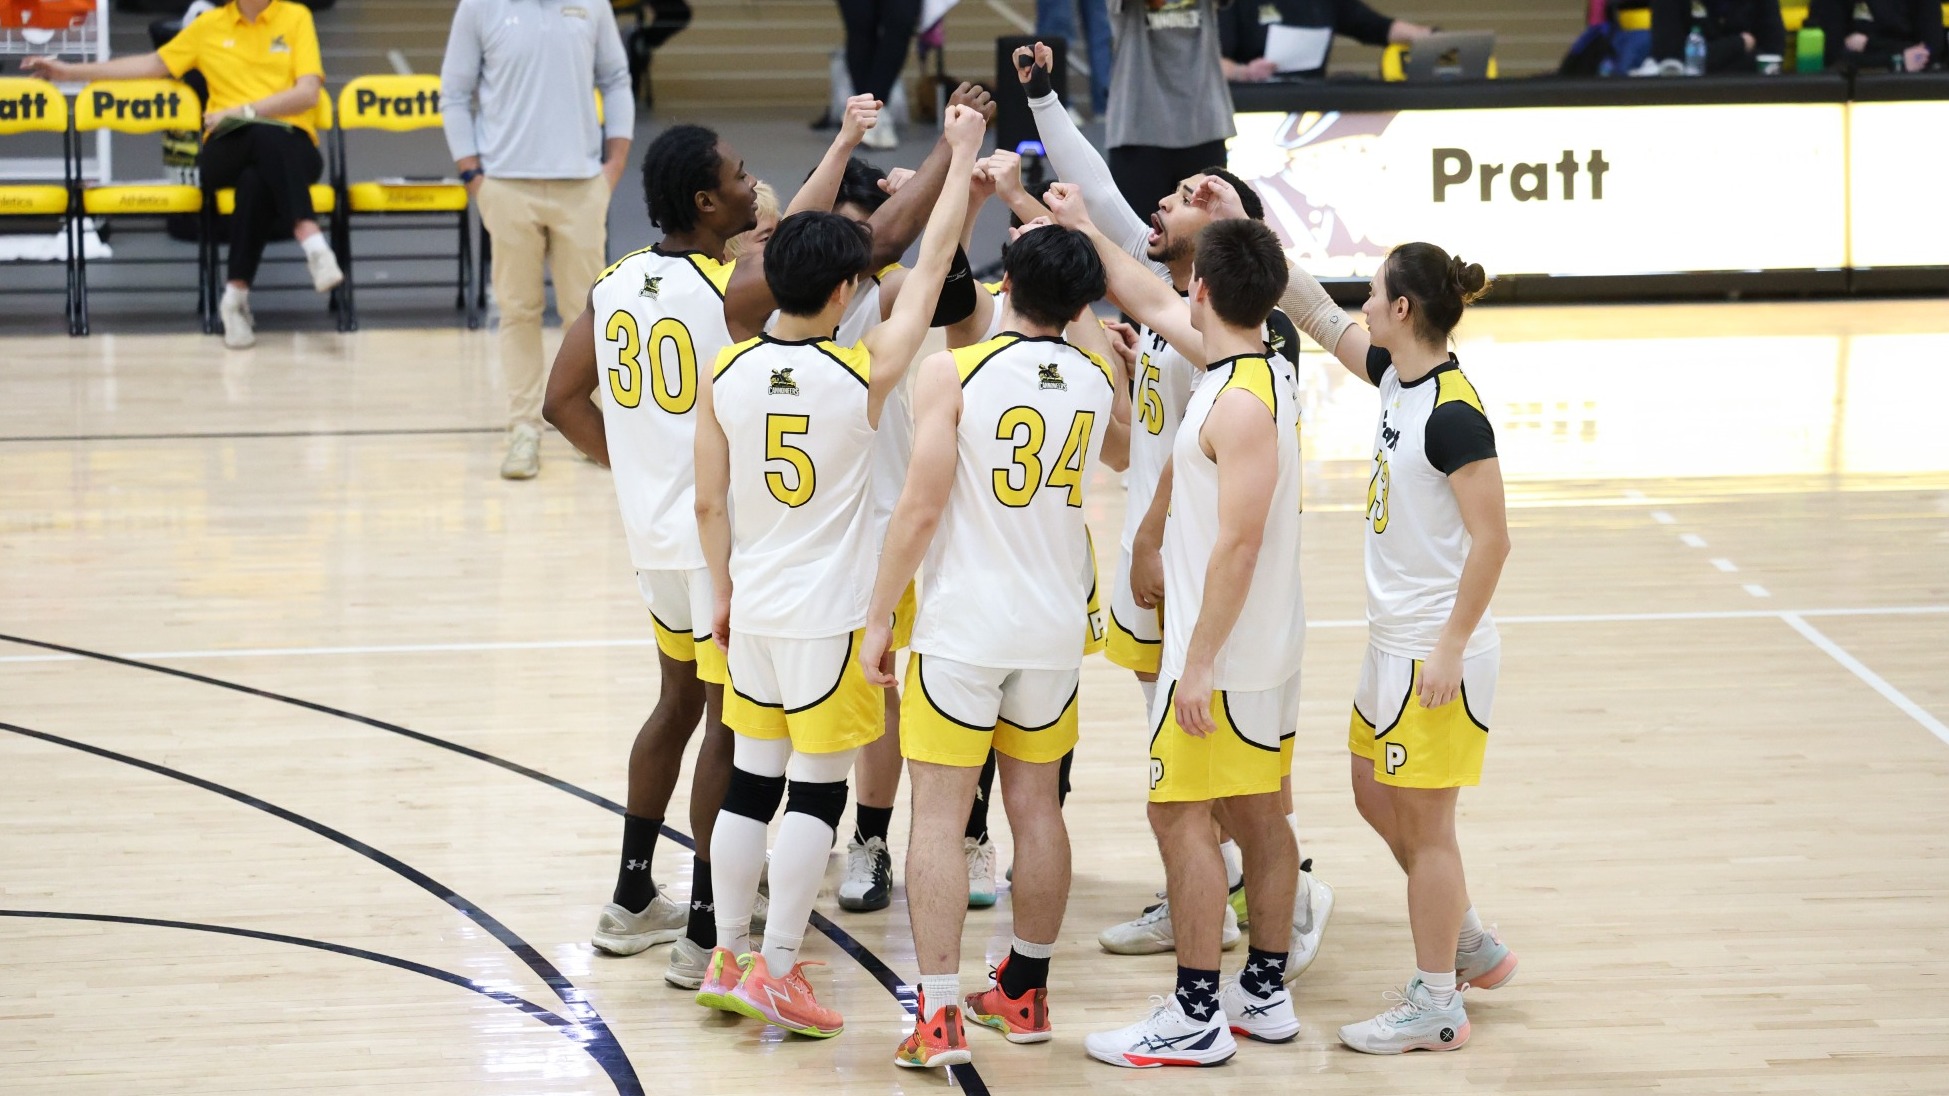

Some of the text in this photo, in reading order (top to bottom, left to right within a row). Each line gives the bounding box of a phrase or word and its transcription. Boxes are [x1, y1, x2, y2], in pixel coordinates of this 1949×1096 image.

[93, 91, 180, 118] Pratt
[356, 88, 440, 115] Pratt
[1432, 148, 1609, 202] Pratt
[605, 309, 698, 414] 30
[1138, 352, 1164, 435] 75
[764, 413, 816, 508] 5
[992, 405, 1095, 508] 34
[1150, 757, 1164, 790] P
[1385, 741, 1407, 775] P
